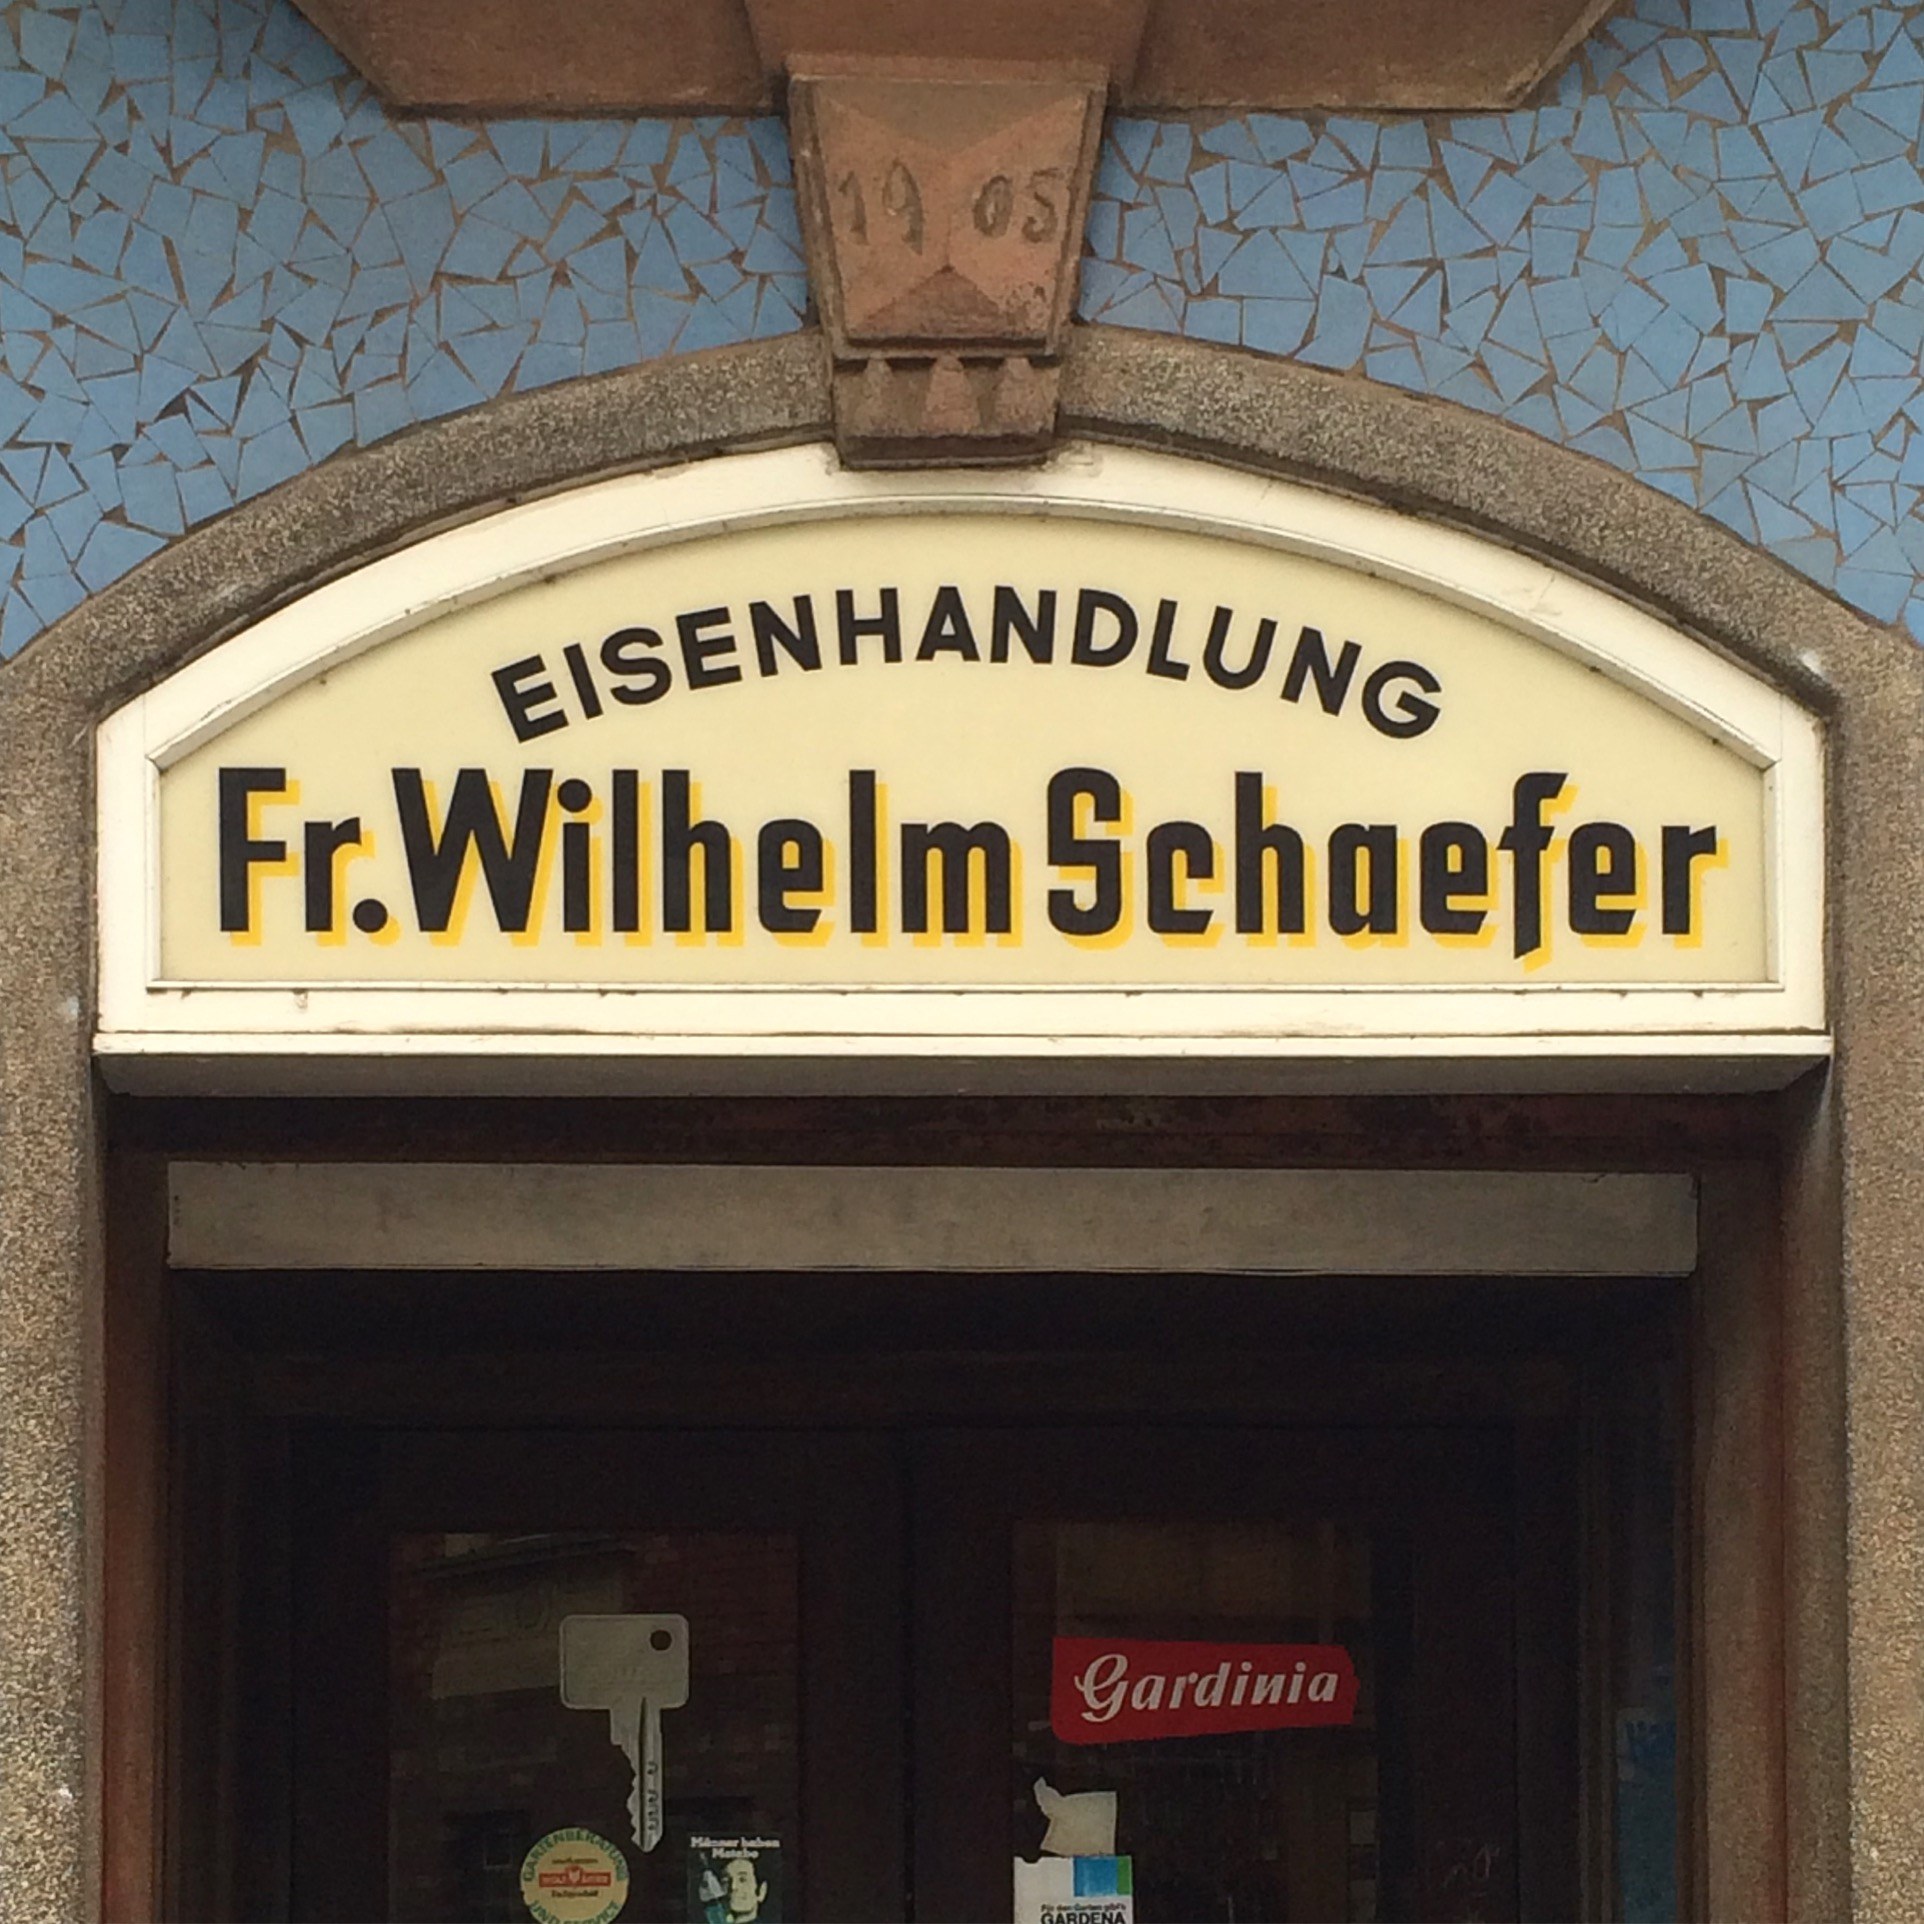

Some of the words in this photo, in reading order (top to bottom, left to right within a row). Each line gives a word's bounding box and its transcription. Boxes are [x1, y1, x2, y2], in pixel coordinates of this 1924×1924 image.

[491, 585, 1442, 743] EISENHANDLUNG
[1046, 766, 1722, 964] Schaefer
[1073, 1652, 1339, 1723] Gardinia
[1040, 1911, 1127, 1924] GARDENA
